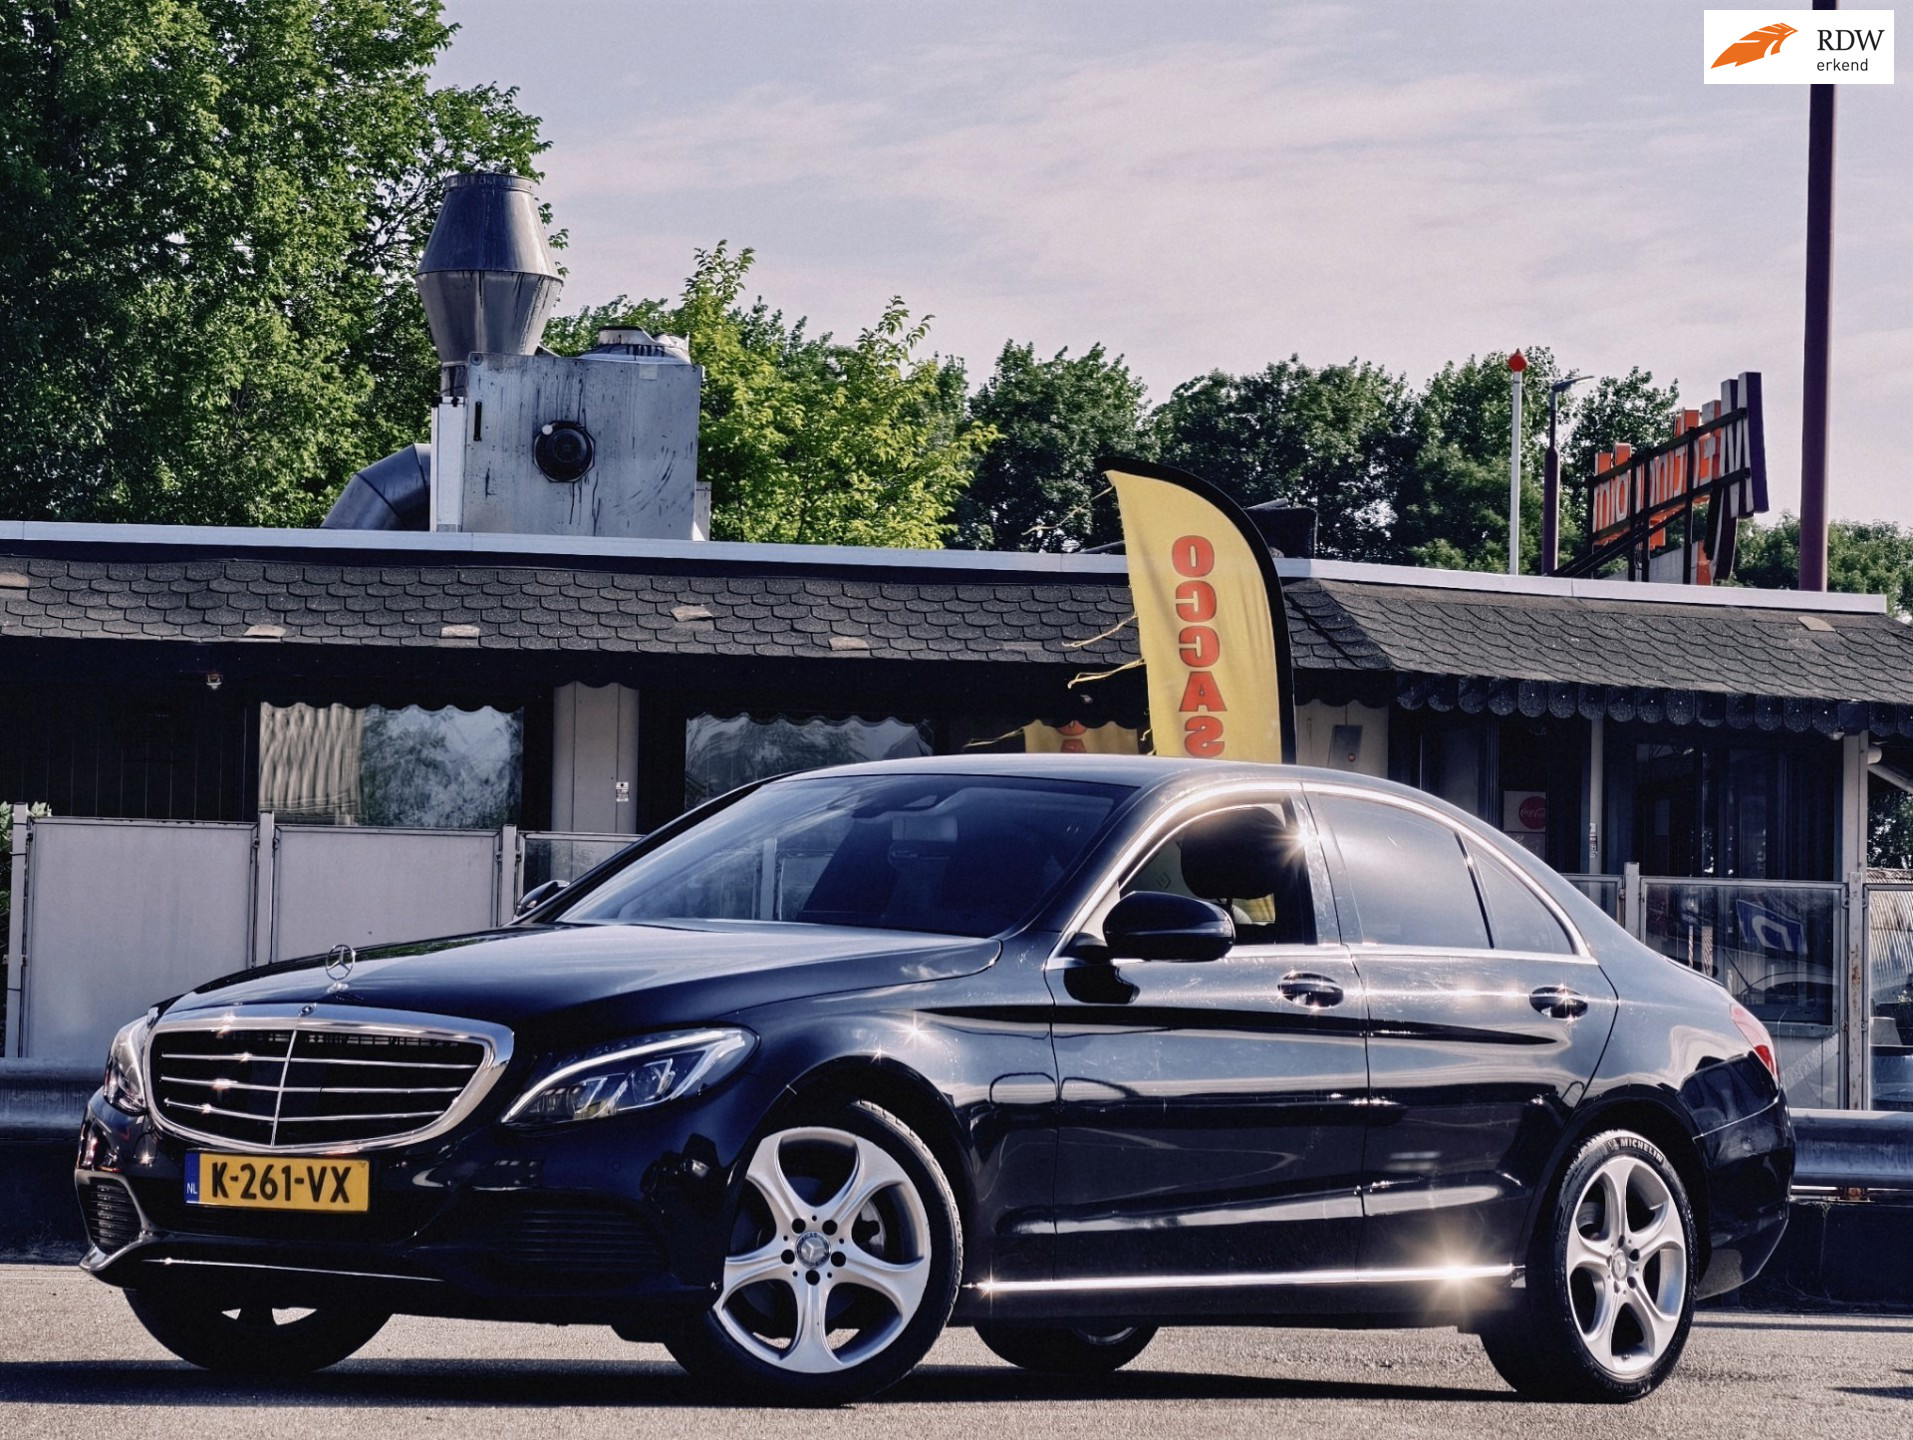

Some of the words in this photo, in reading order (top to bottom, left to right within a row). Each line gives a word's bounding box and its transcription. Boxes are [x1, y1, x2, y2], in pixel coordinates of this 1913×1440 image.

[1620, 1138, 1664, 1163] MICHELIN
[186, 1183, 198, 1195] NL
[212, 1161, 352, 1203] K-261-VX
